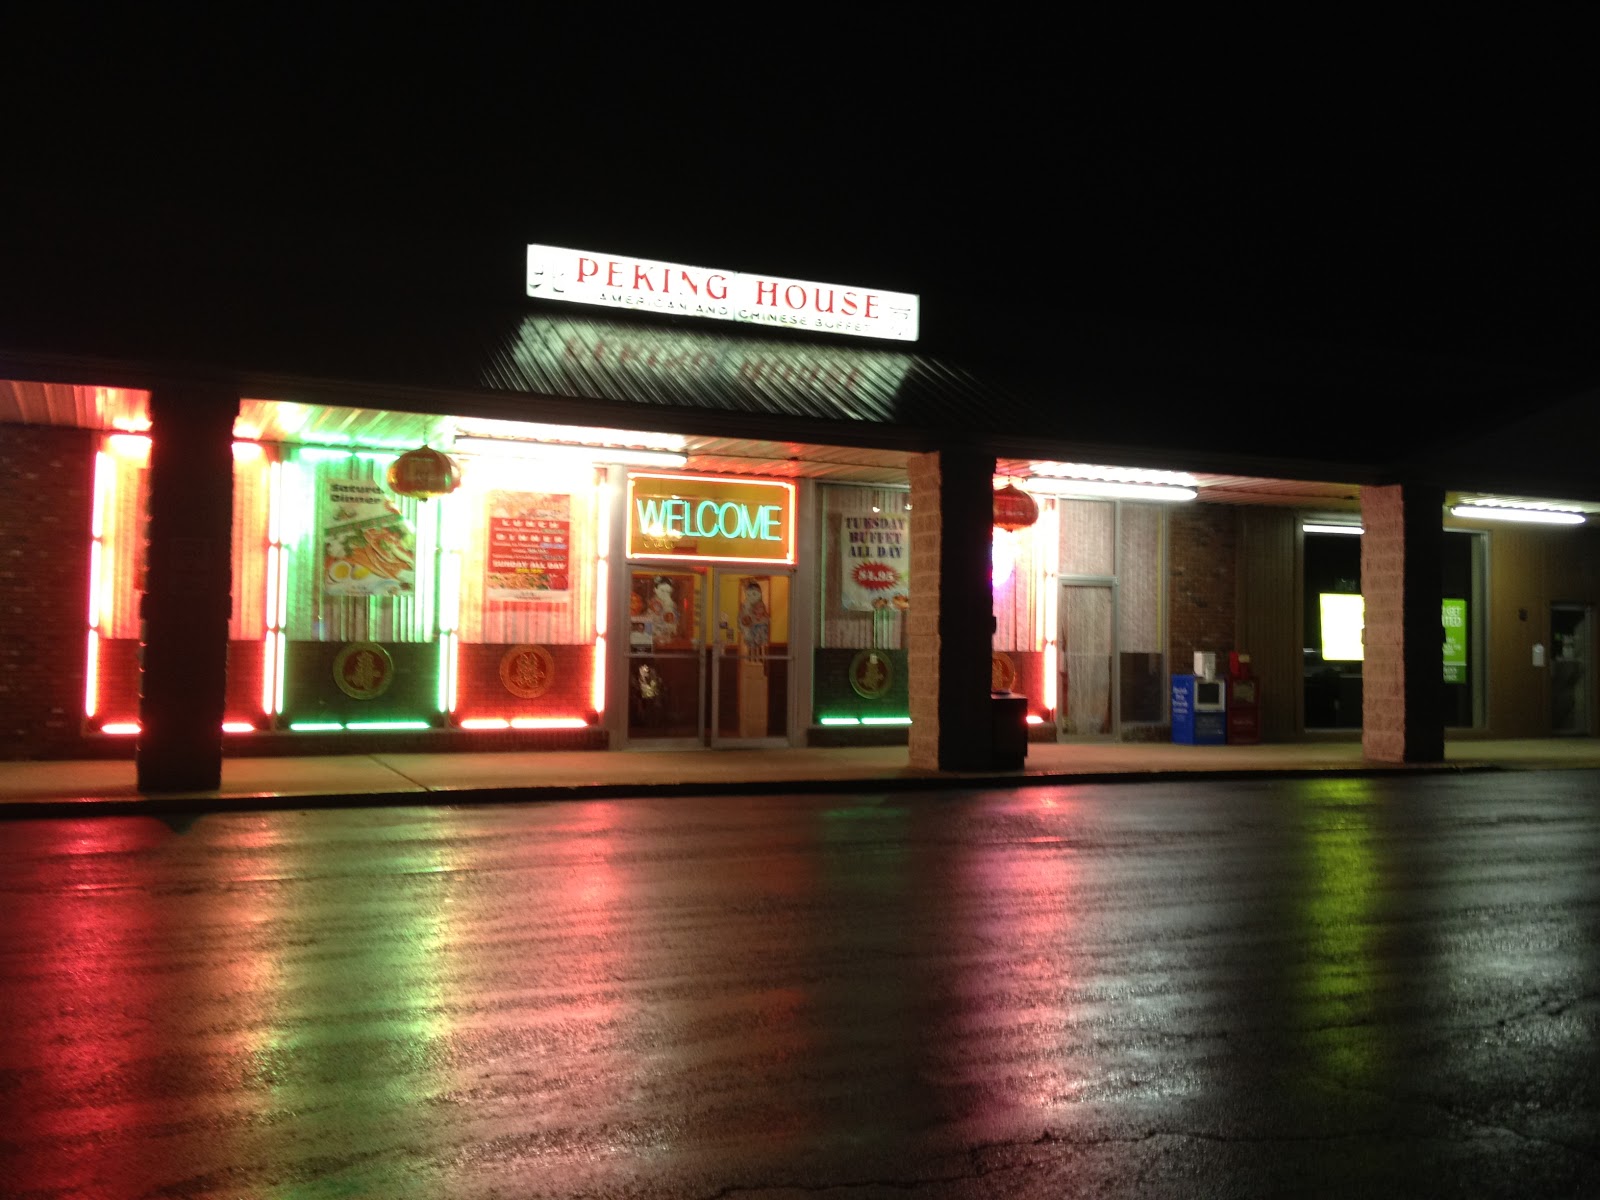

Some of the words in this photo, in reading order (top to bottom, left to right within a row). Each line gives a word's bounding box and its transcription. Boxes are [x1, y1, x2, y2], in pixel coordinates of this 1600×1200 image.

[576, 257, 729, 300] PEKING
[755, 280, 880, 319] HOUSE
[598, 292, 687, 311] AMERICAN
[695, 304, 728, 317] AND
[737, 308, 808, 327] CHINESE
[636, 497, 782, 541] WELCOME
[846, 516, 907, 531] TUESDAY
[496, 533, 564, 543] DINNER
[849, 531, 902, 545] BUFFET
[849, 545, 875, 558] ALL
[877, 546, 904, 559] DAY
